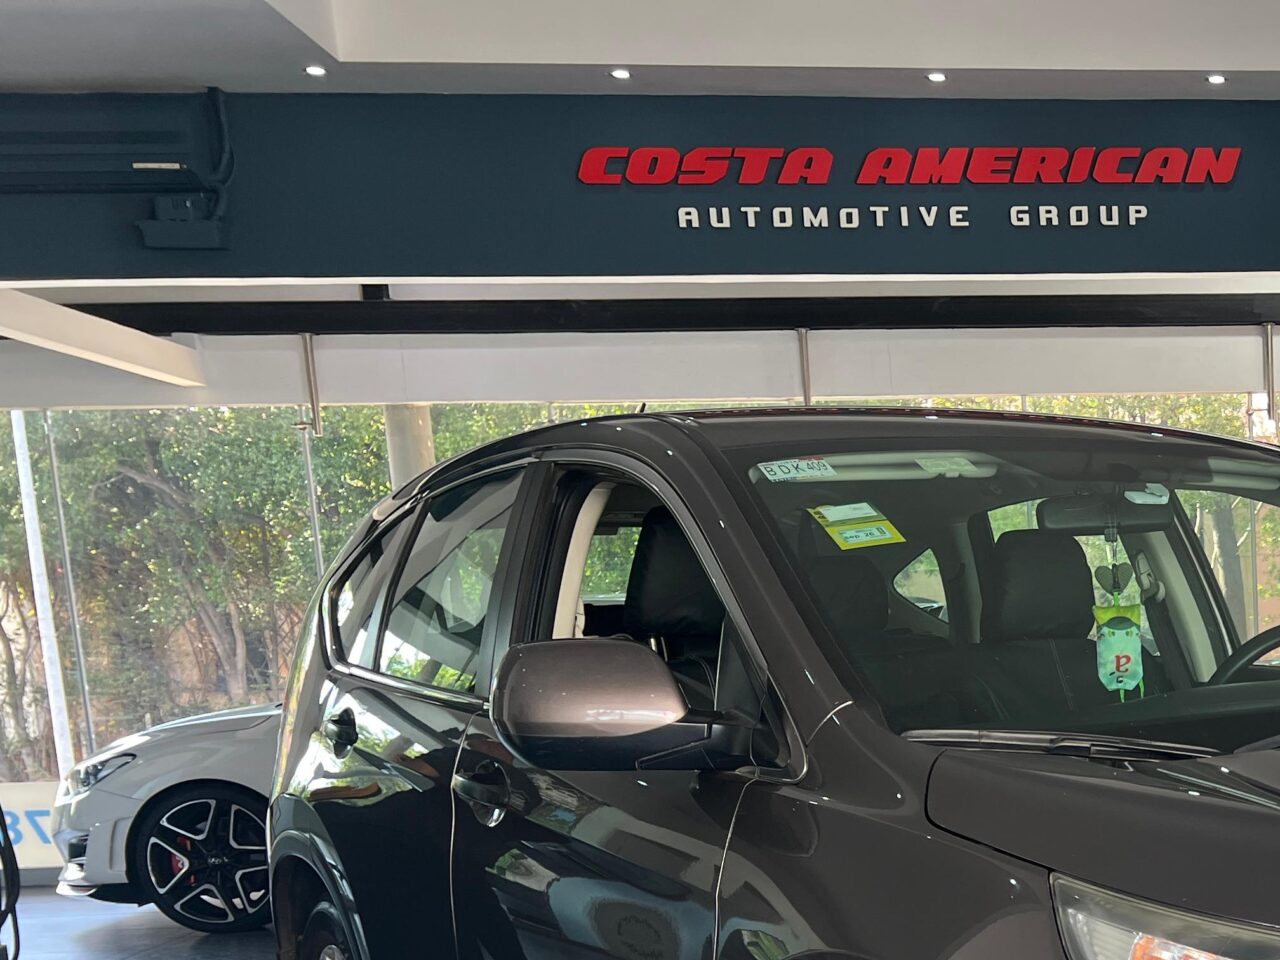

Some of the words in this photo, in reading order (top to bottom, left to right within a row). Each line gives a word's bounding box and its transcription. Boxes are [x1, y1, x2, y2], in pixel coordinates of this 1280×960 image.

[576, 146, 834, 186] COSTA
[855, 146, 1243, 185] AMERICAN
[677, 205, 970, 229] AUTOMOTIVE
[1009, 204, 1150, 227] GROUP
